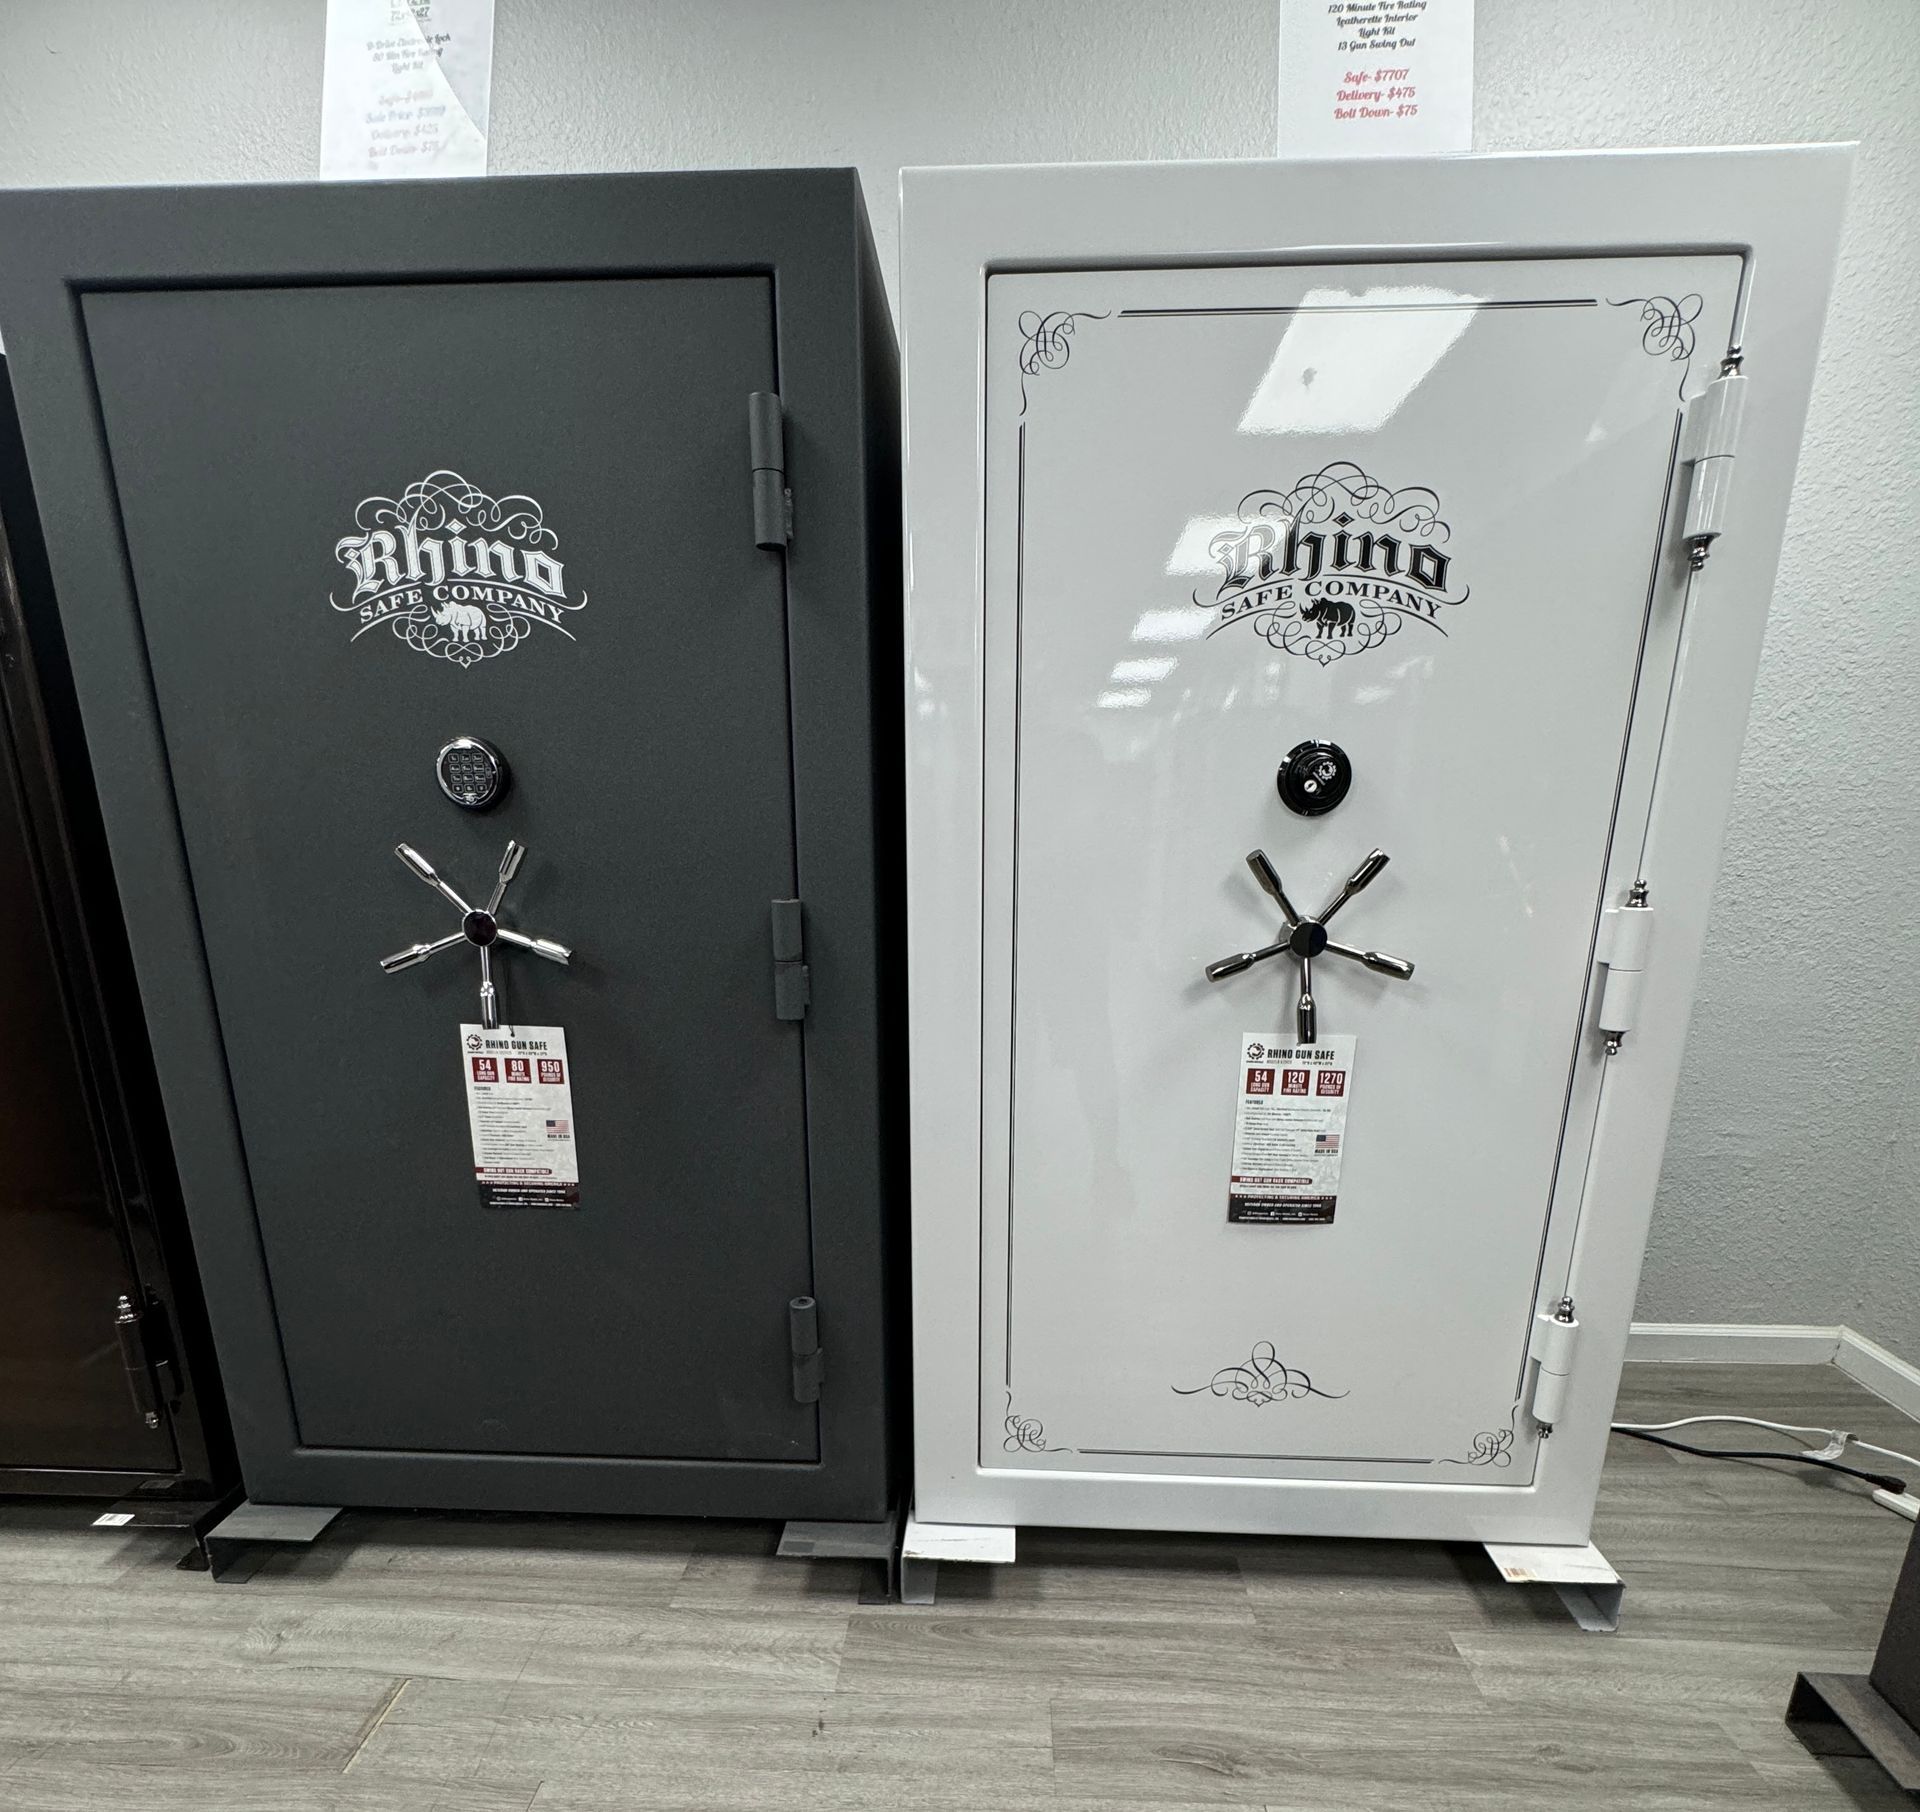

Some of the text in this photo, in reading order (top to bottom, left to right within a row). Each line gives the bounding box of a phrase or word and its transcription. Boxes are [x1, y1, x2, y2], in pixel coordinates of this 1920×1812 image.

[1328, 0, 1427, 14] 120 Minute Fire Rating
[1336, 13, 1418, 28] Leatherette Interior
[1358, 26, 1396, 38] Light Kit
[1338, 38, 1416, 52] 13 Gun Swing Out
[1344, 69, 1409, 85] Safe- $7707
[1336, 86, 1416, 103] Delivery- $475
[1334, 104, 1418, 119] Bolt Down- $75
[335, 508, 567, 604] Rhino
[1208, 505, 1452, 600] Rhino
[360, 585, 564, 623] SAFE COMPANY
[1221, 580, 1442, 620] SAFE COMPANY
[485, 1039, 548, 1051] RHINO GUN SAFE
[1267, 1049, 1335, 1060] RHINO GUN SAFE
[479, 1059, 491, 1071] 54
[511, 1060, 524, 1072] 80
[541, 1061, 560, 1073] 950
[1254, 1070, 1268, 1082] 54
[1288, 1071, 1305, 1084] 120
[1320, 1072, 1343, 1084] 1270
